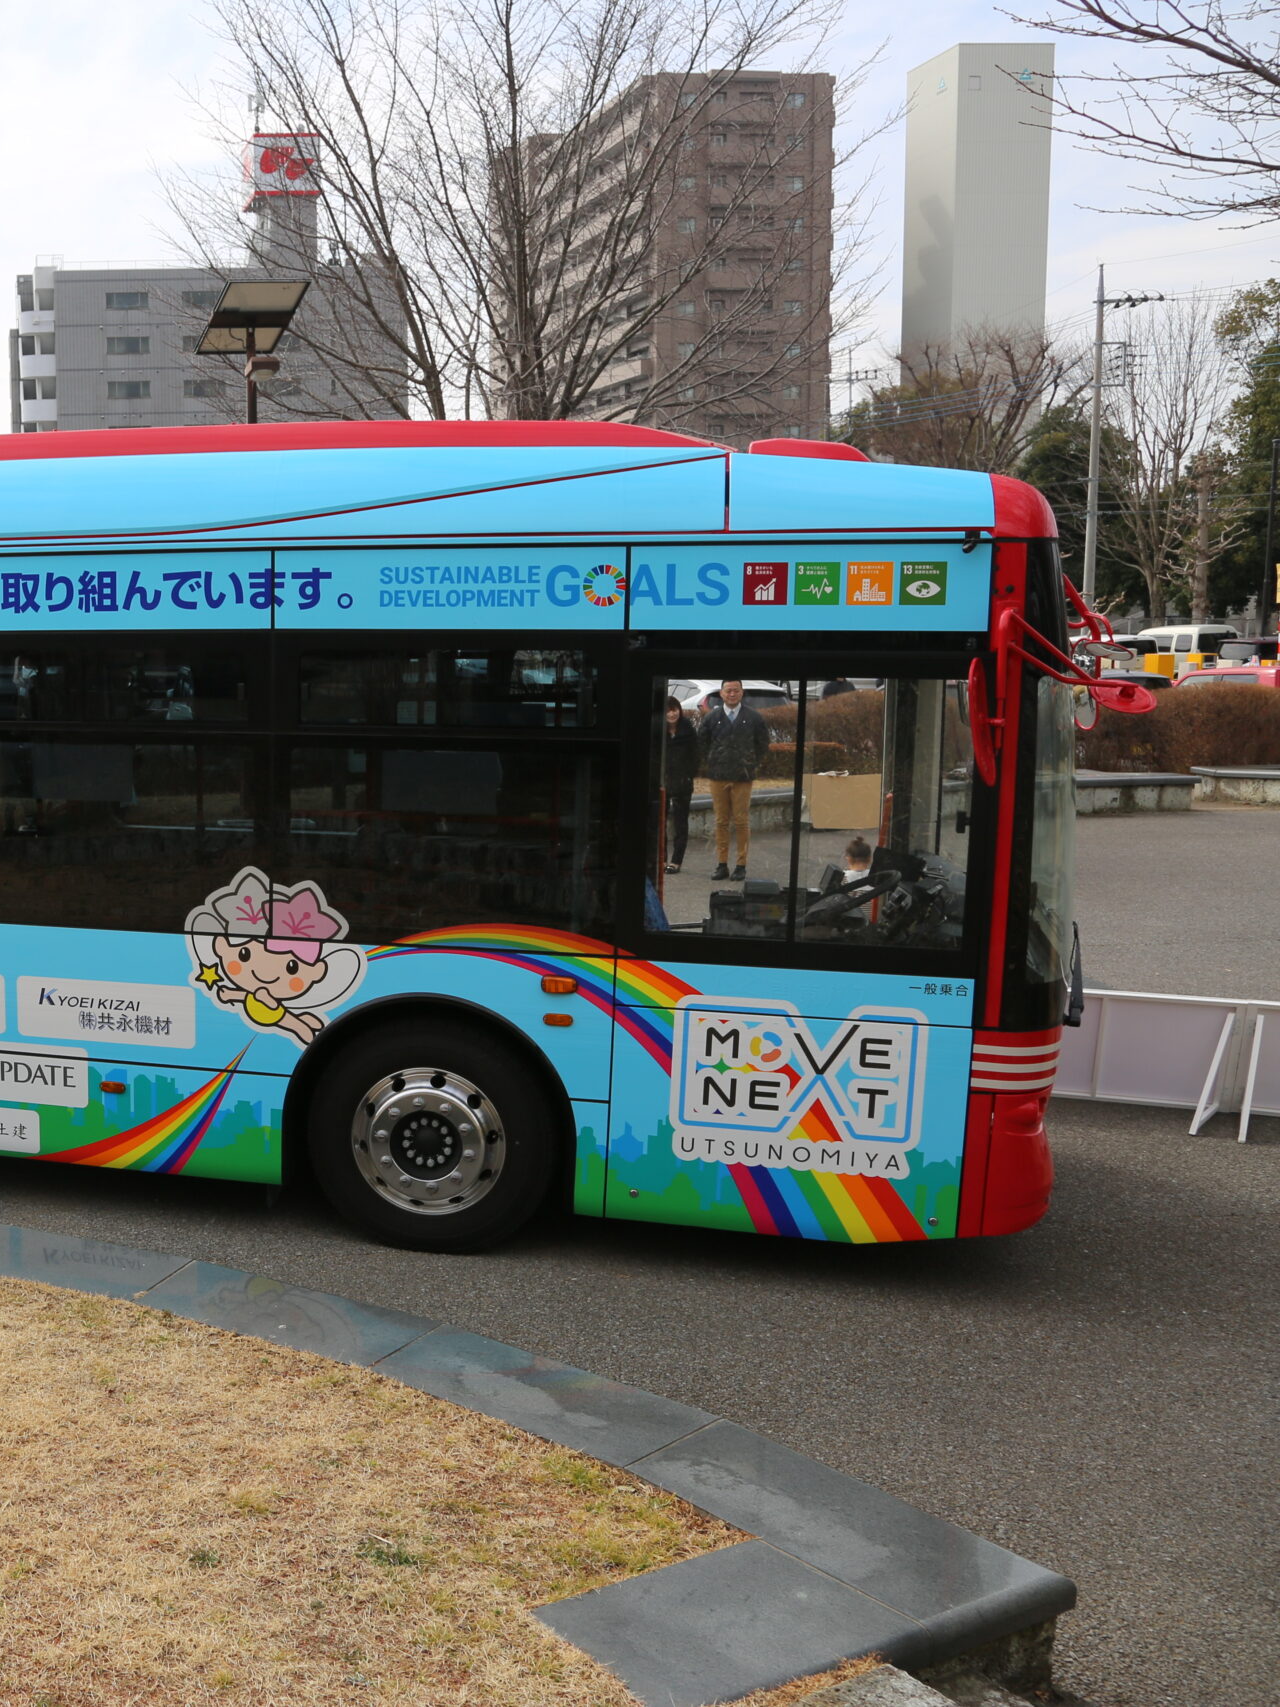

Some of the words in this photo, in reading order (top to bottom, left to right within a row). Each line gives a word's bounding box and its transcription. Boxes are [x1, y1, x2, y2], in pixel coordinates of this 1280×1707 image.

[379, 565, 541, 585] SUSTAINABLE
[746, 565, 752, 575] 8
[798, 565, 804, 575] 3
[850, 565, 858, 575] 11
[903, 565, 913, 575] 13
[545, 562, 730, 607] GOALS
[379, 589, 540, 608] DEVELOPMENT
[38, 987, 94, 1008] KYOEI
[97, 998, 141, 1012] KIZAI
[908, 983, 969, 997] 一般乗合
[705, 1024, 893, 1075] MOVE
[702, 1074, 890, 1119] NEXT
[681, 1136, 901, 1171] UTSUNOMIYA
